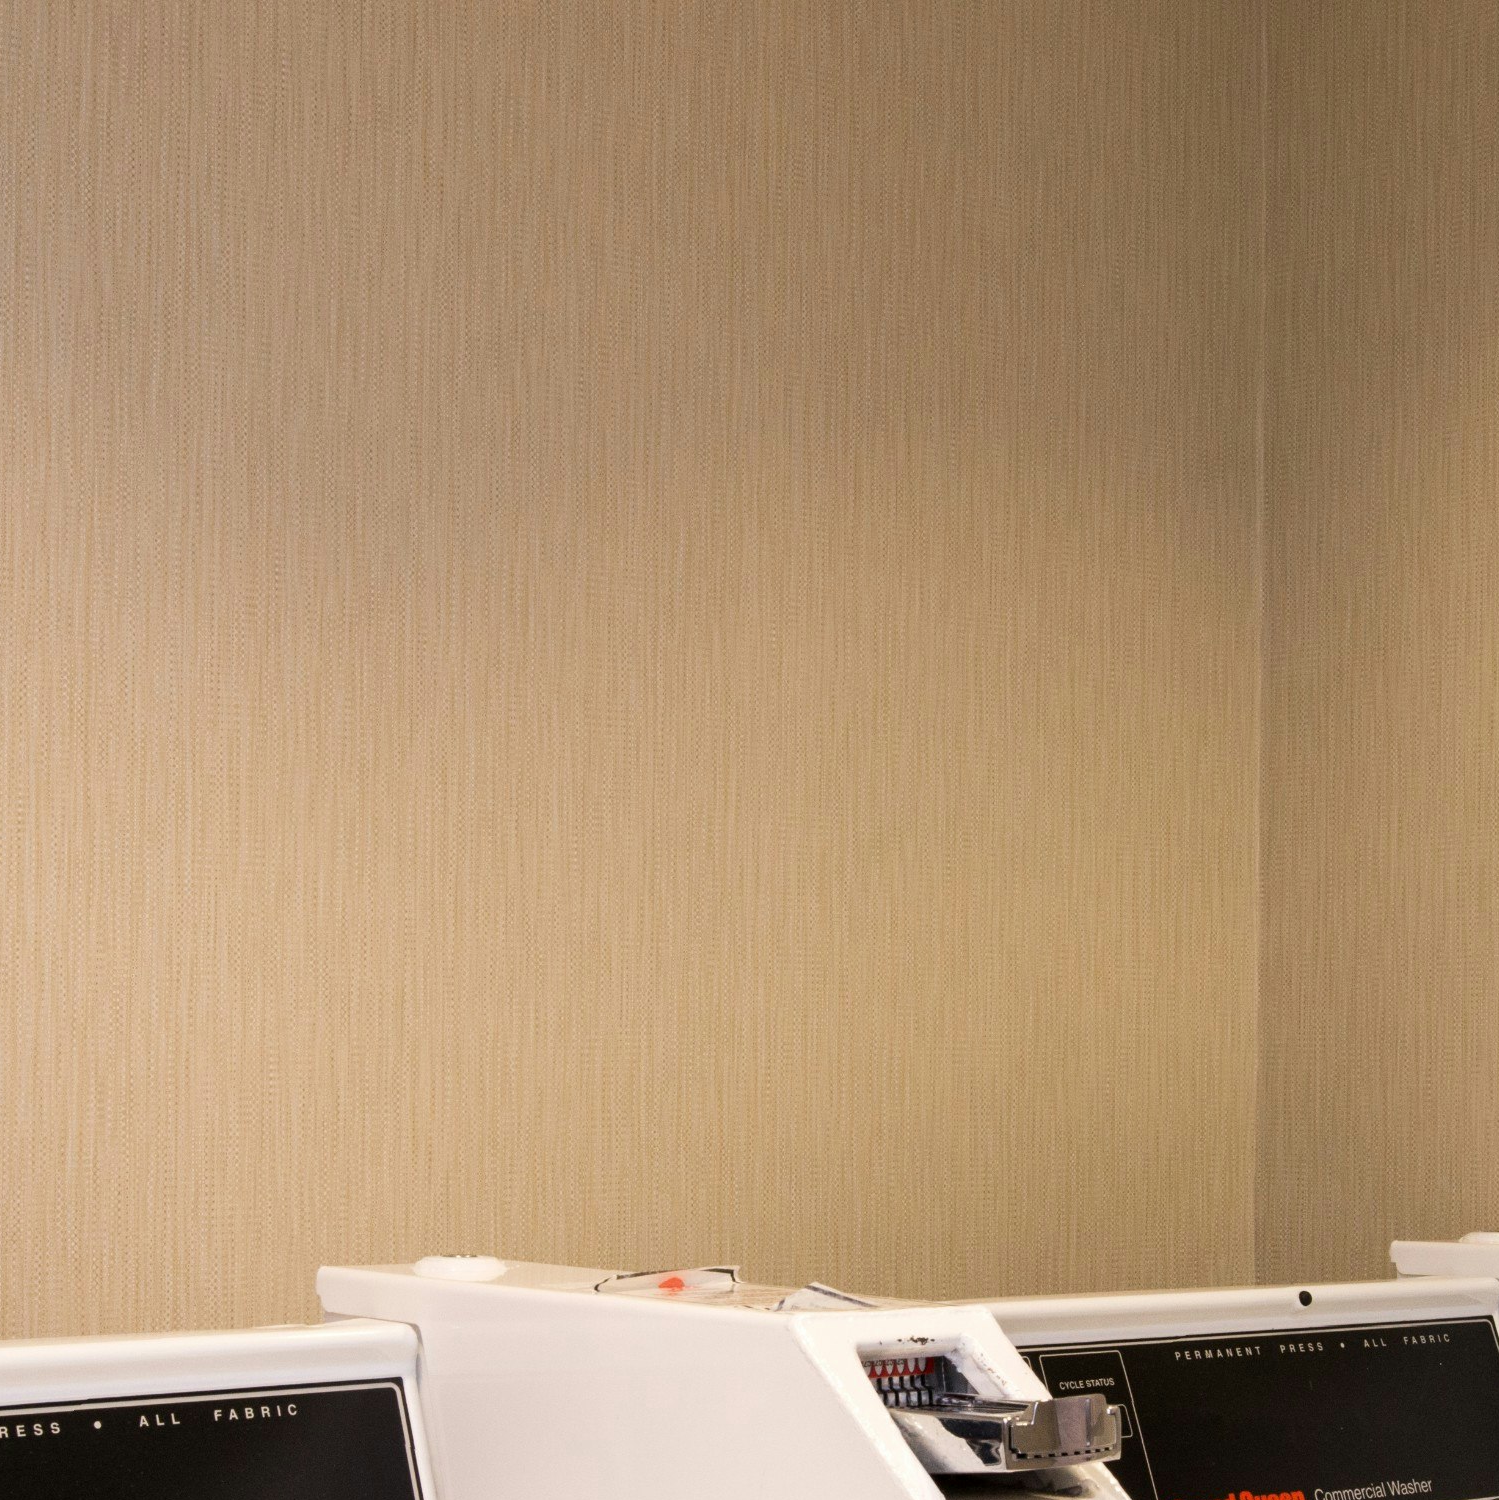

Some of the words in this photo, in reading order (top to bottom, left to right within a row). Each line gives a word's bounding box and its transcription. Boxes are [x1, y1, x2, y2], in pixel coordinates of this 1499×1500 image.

[1174, 1346, 1261, 1361] PERMANENT
[1279, 1342, 1324, 1354] PRESS
[1363, 1338, 1388, 1349] ALL
[1403, 1333, 1452, 1346] FABRIC
[1059, 1380, 1085, 1390] CYCLE
[1085, 1377, 1115, 1388] STATUS
[139, 1412, 181, 1428] ALL
[213, 1403, 298, 1422] FABRIC
[1387, 1477, 1433, 1497] Washer
